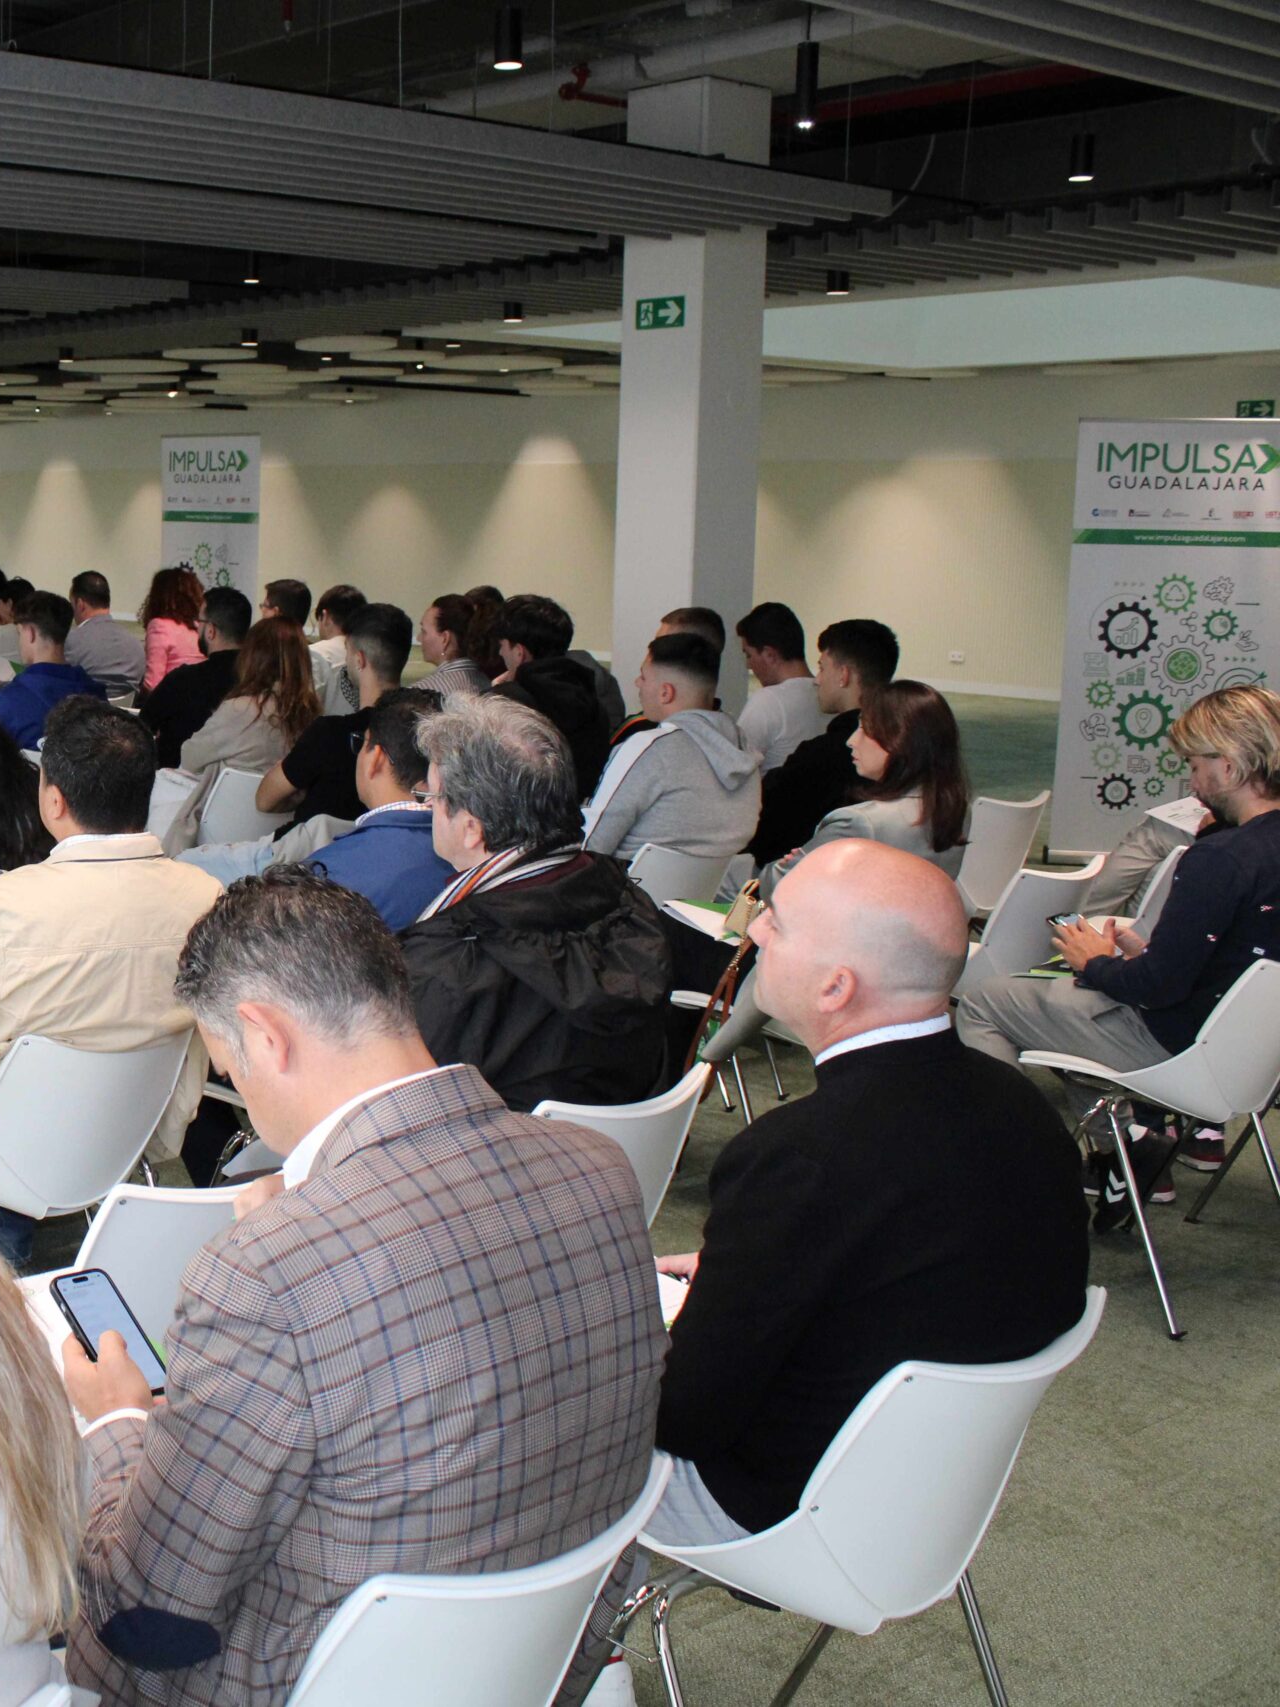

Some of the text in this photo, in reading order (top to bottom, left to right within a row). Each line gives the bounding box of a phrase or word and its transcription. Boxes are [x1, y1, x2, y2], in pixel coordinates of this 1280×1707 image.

[169, 450, 237, 472] IMPULSA
[1097, 442, 1258, 474] IMPULSA
[174, 473, 241, 484] GUADALAJARA
[1108, 475, 1265, 491] GUADALAJARA
[1134, 534, 1246, 544] www.impulsaguadalajara.com
